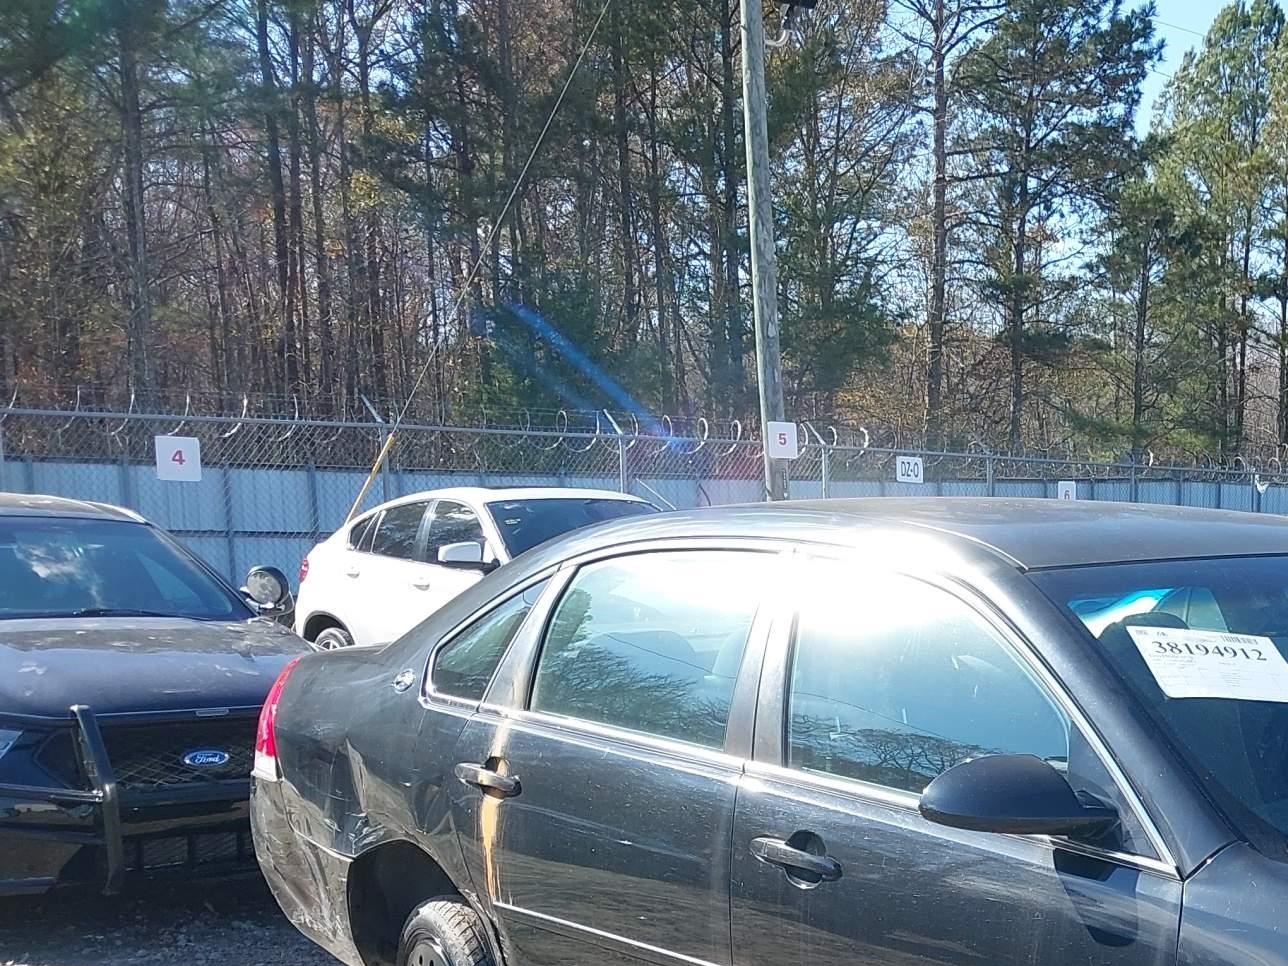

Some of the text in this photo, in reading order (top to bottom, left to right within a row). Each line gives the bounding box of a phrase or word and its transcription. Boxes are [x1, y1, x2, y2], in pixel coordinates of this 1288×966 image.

[778, 432, 787, 446] 5
[171, 449, 186, 466] 4
[1151, 640, 1267, 661] 38194912
[195, 753, 221, 764] Ford
